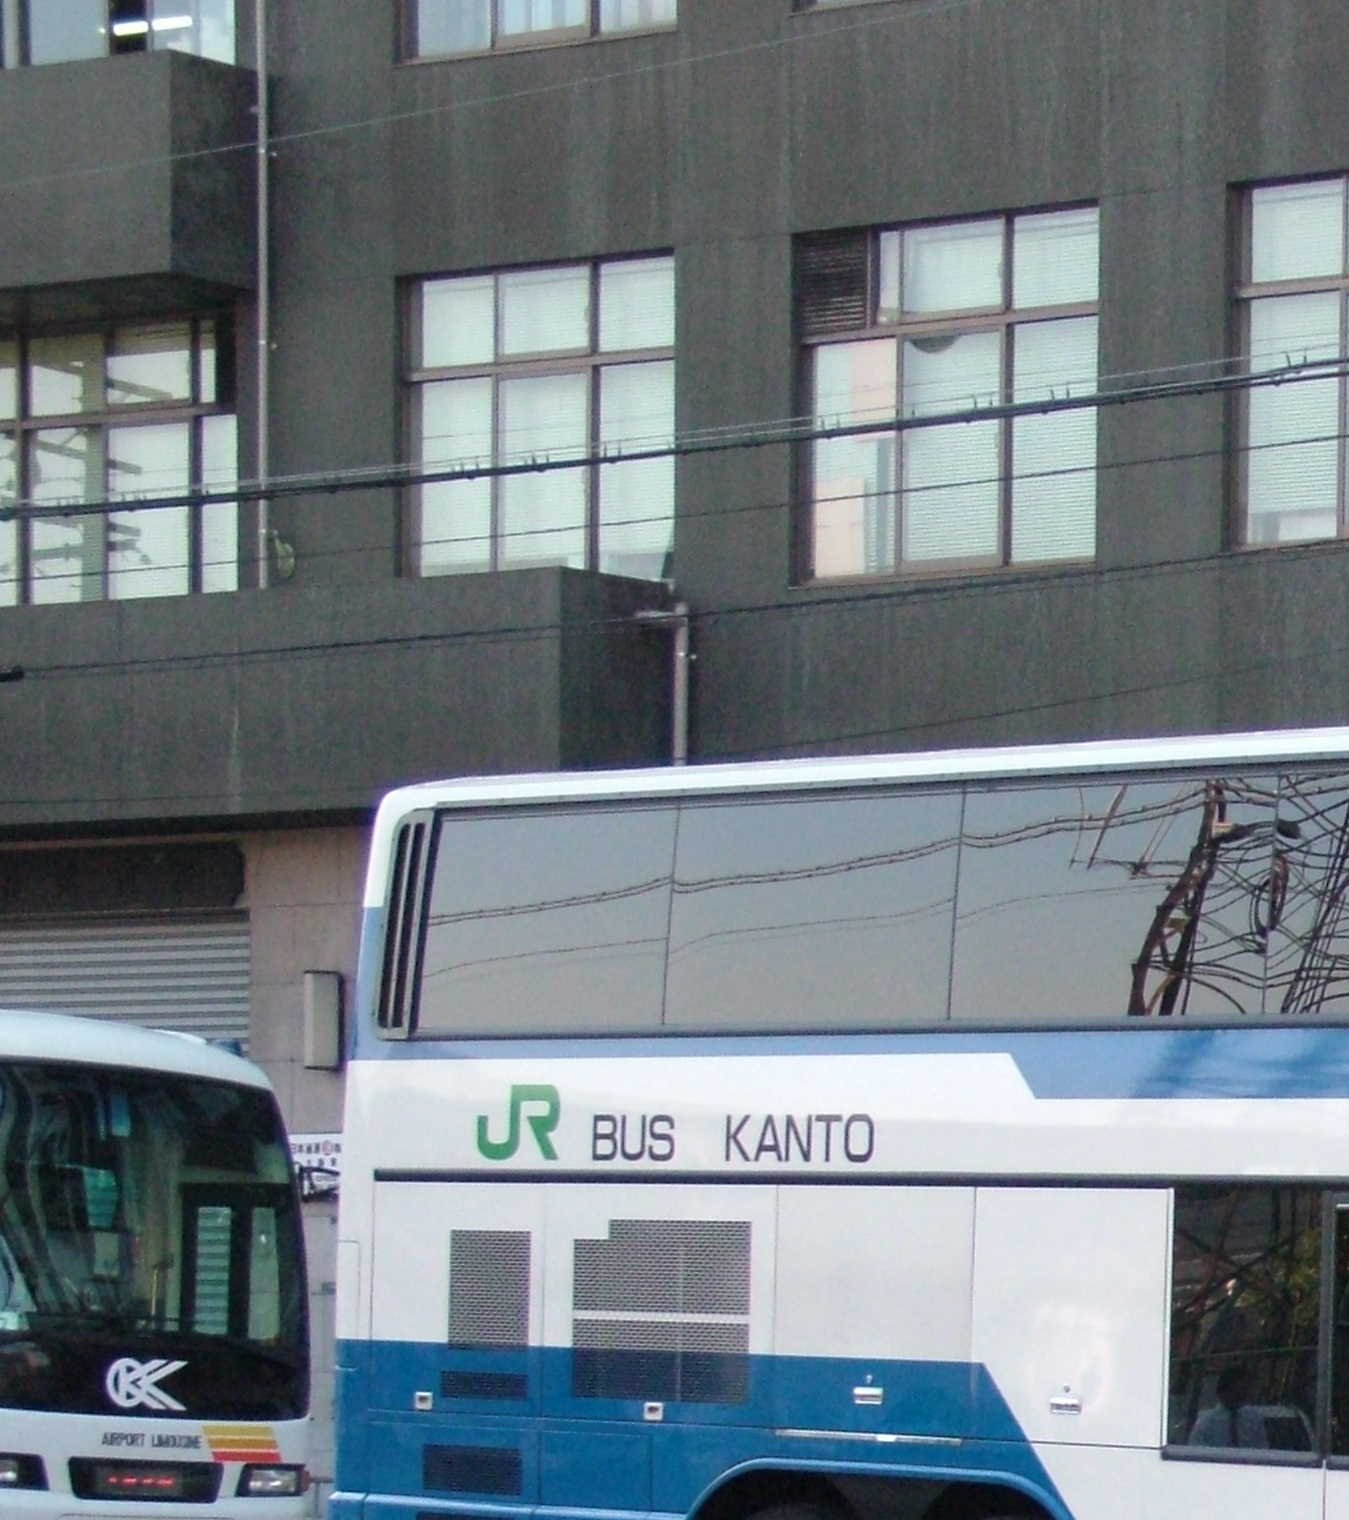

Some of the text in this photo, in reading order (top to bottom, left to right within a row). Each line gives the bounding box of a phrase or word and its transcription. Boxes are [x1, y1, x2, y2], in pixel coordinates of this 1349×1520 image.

[477, 1084, 876, 1163] JR BUS KANTO
